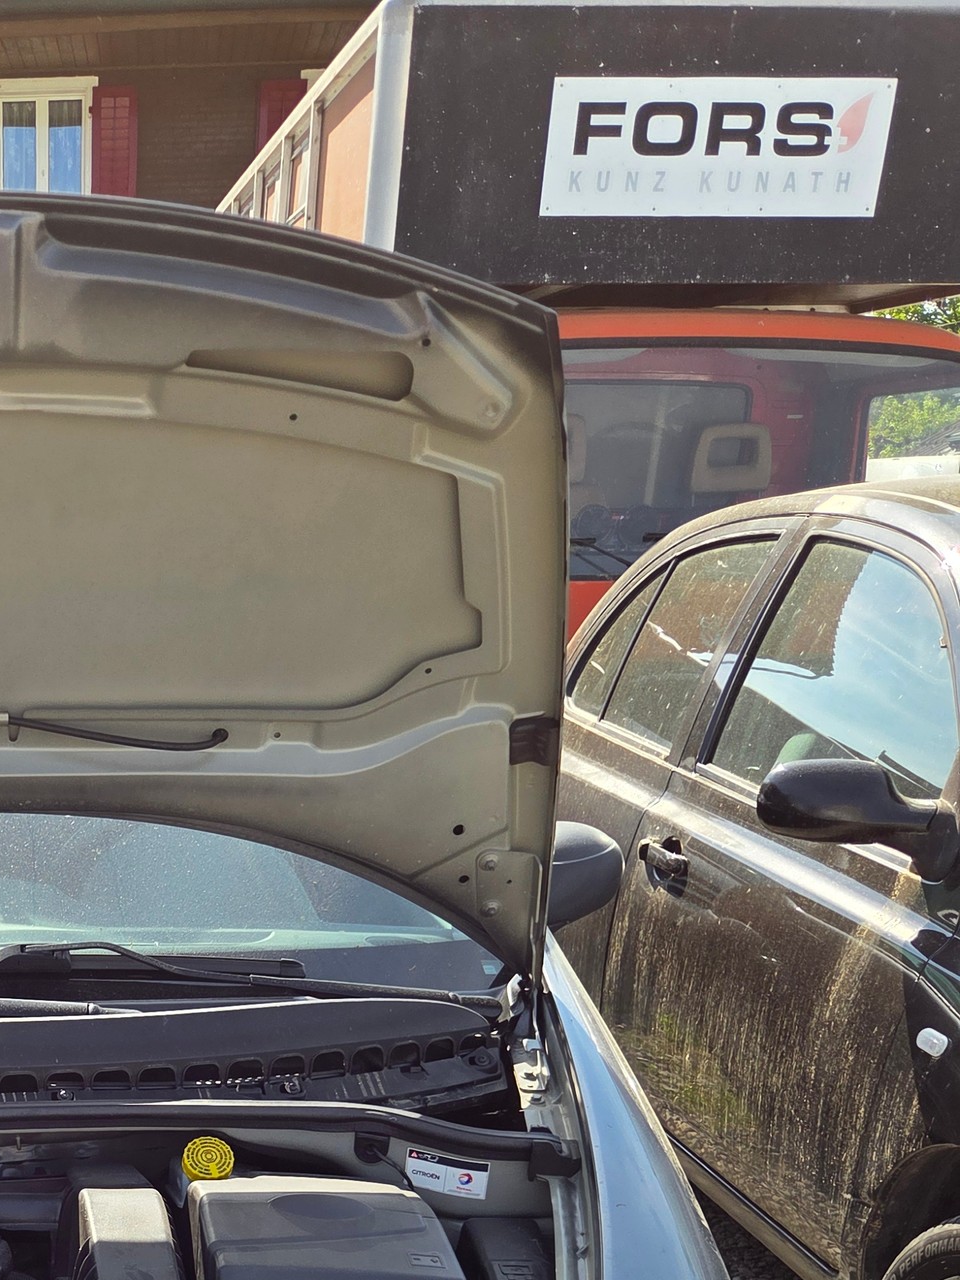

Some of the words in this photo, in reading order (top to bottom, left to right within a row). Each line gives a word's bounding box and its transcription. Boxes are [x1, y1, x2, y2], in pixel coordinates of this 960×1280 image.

[572, 101, 834, 157] FORS
[568, 170, 667, 193] KUNZ
[698, 170, 852, 193] KUNATH
